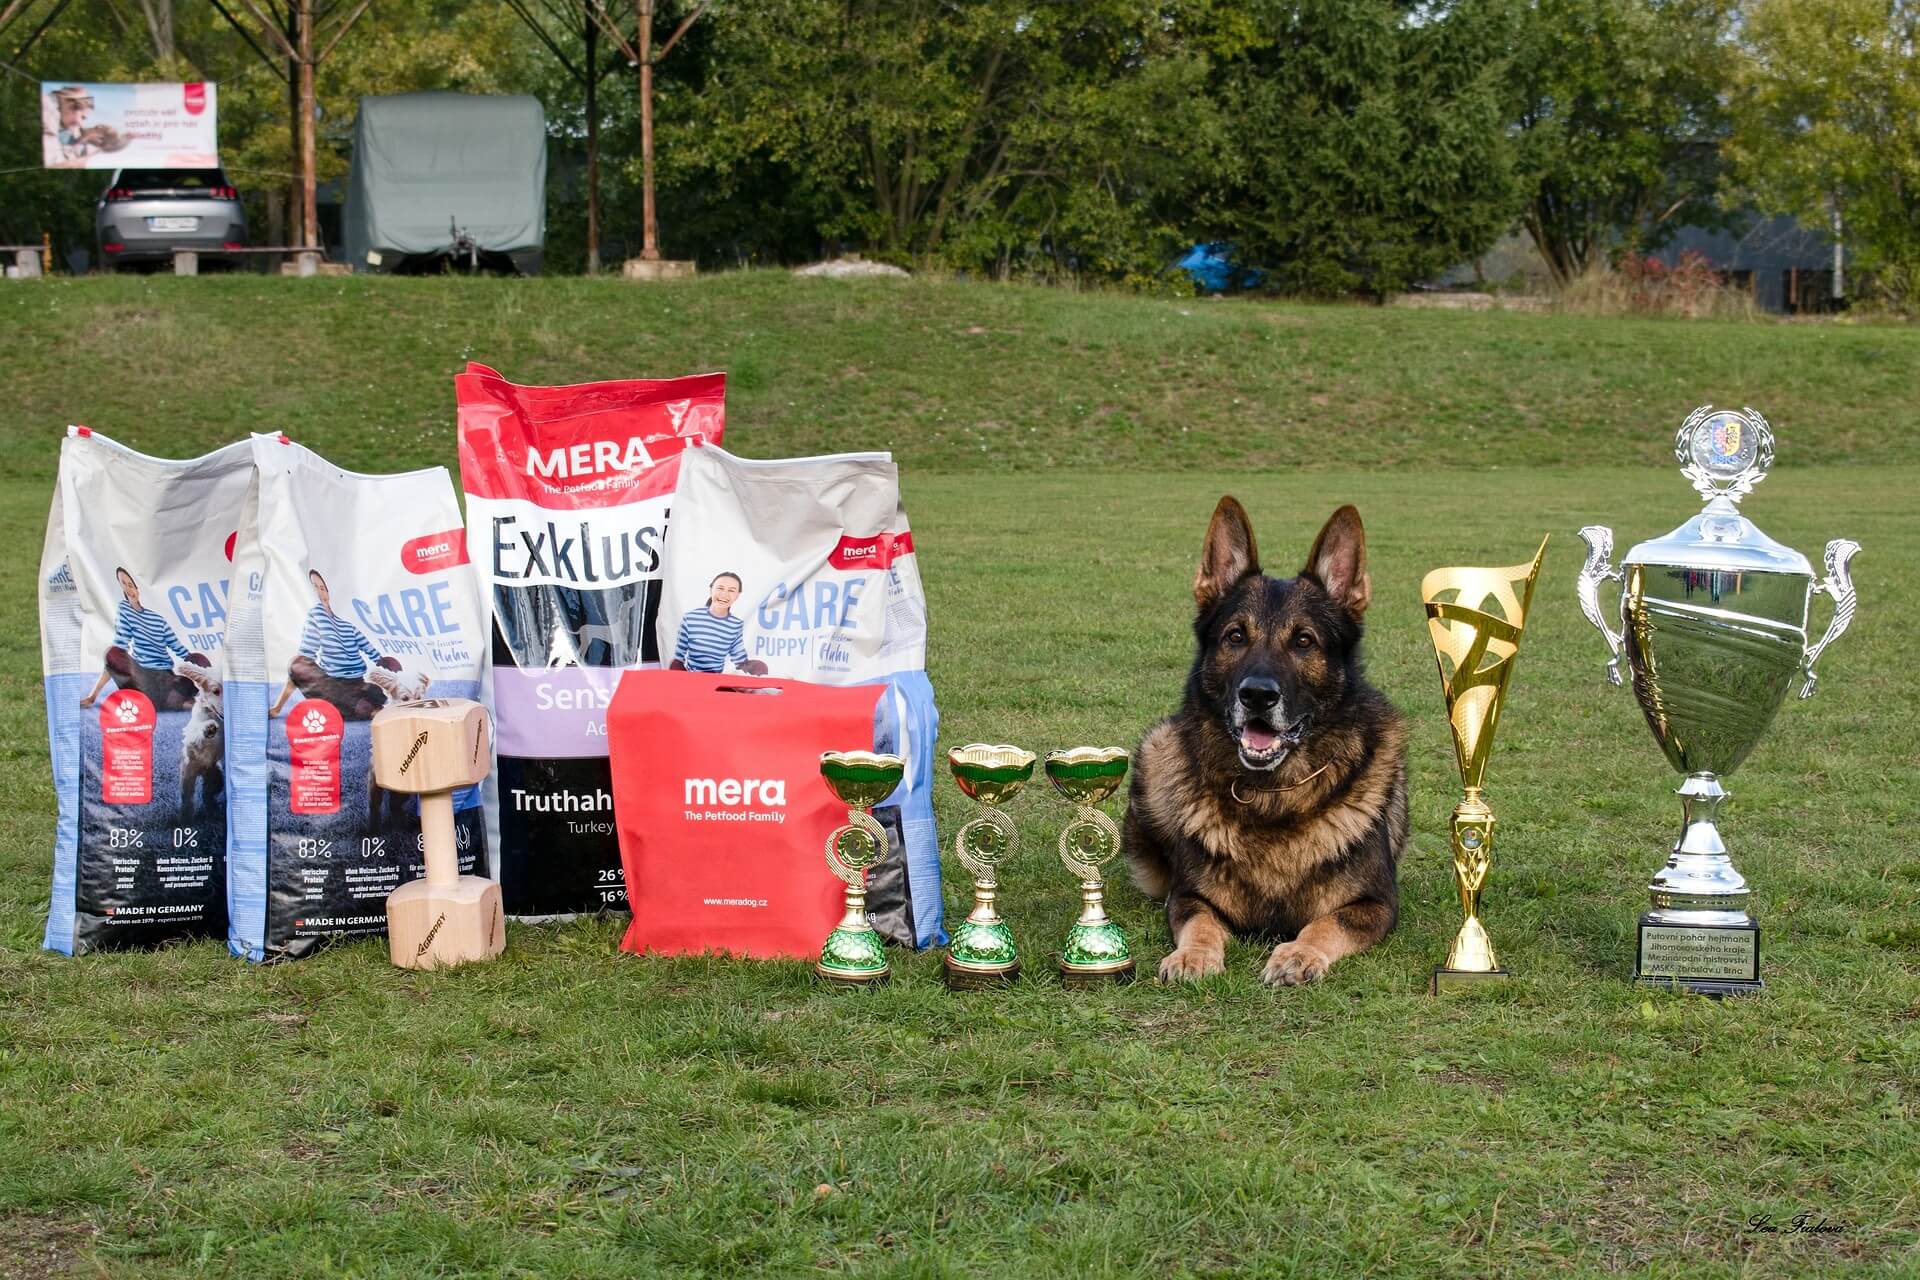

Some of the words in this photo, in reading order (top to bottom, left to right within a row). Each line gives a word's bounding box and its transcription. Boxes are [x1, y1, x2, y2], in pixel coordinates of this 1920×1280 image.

[526, 436, 655, 478] MERA
[544, 486, 560, 494] The
[606, 477, 640, 490] Family
[416, 543, 448, 558] mera
[844, 544, 876, 556] mera
[352, 581, 460, 637] CARE
[758, 578, 865, 630] CARE
[378, 638, 422, 655] PUPPY
[756, 636, 807, 656] PUPPY
[685, 778, 786, 806] mera
[684, 811, 702, 820] The
[705, 811, 746, 821] Petfood
[749, 812, 785, 824] Family
[568, 821, 614, 836] Turkey
[110, 828, 144, 848] 83%
[174, 828, 198, 848] 0%
[299, 839, 332, 858] 83%
[362, 838, 386, 858] 0%
[116, 907, 144, 915] MADE
[158, 904, 204, 914] GERMANY
[704, 898, 768, 908] www.meradog.cz
[306, 918, 334, 926] MADE
[1708, 934, 1750, 943] hejtmana
[1724, 946, 1746, 955] kraje
[1723, 966, 1743, 975] Brna
